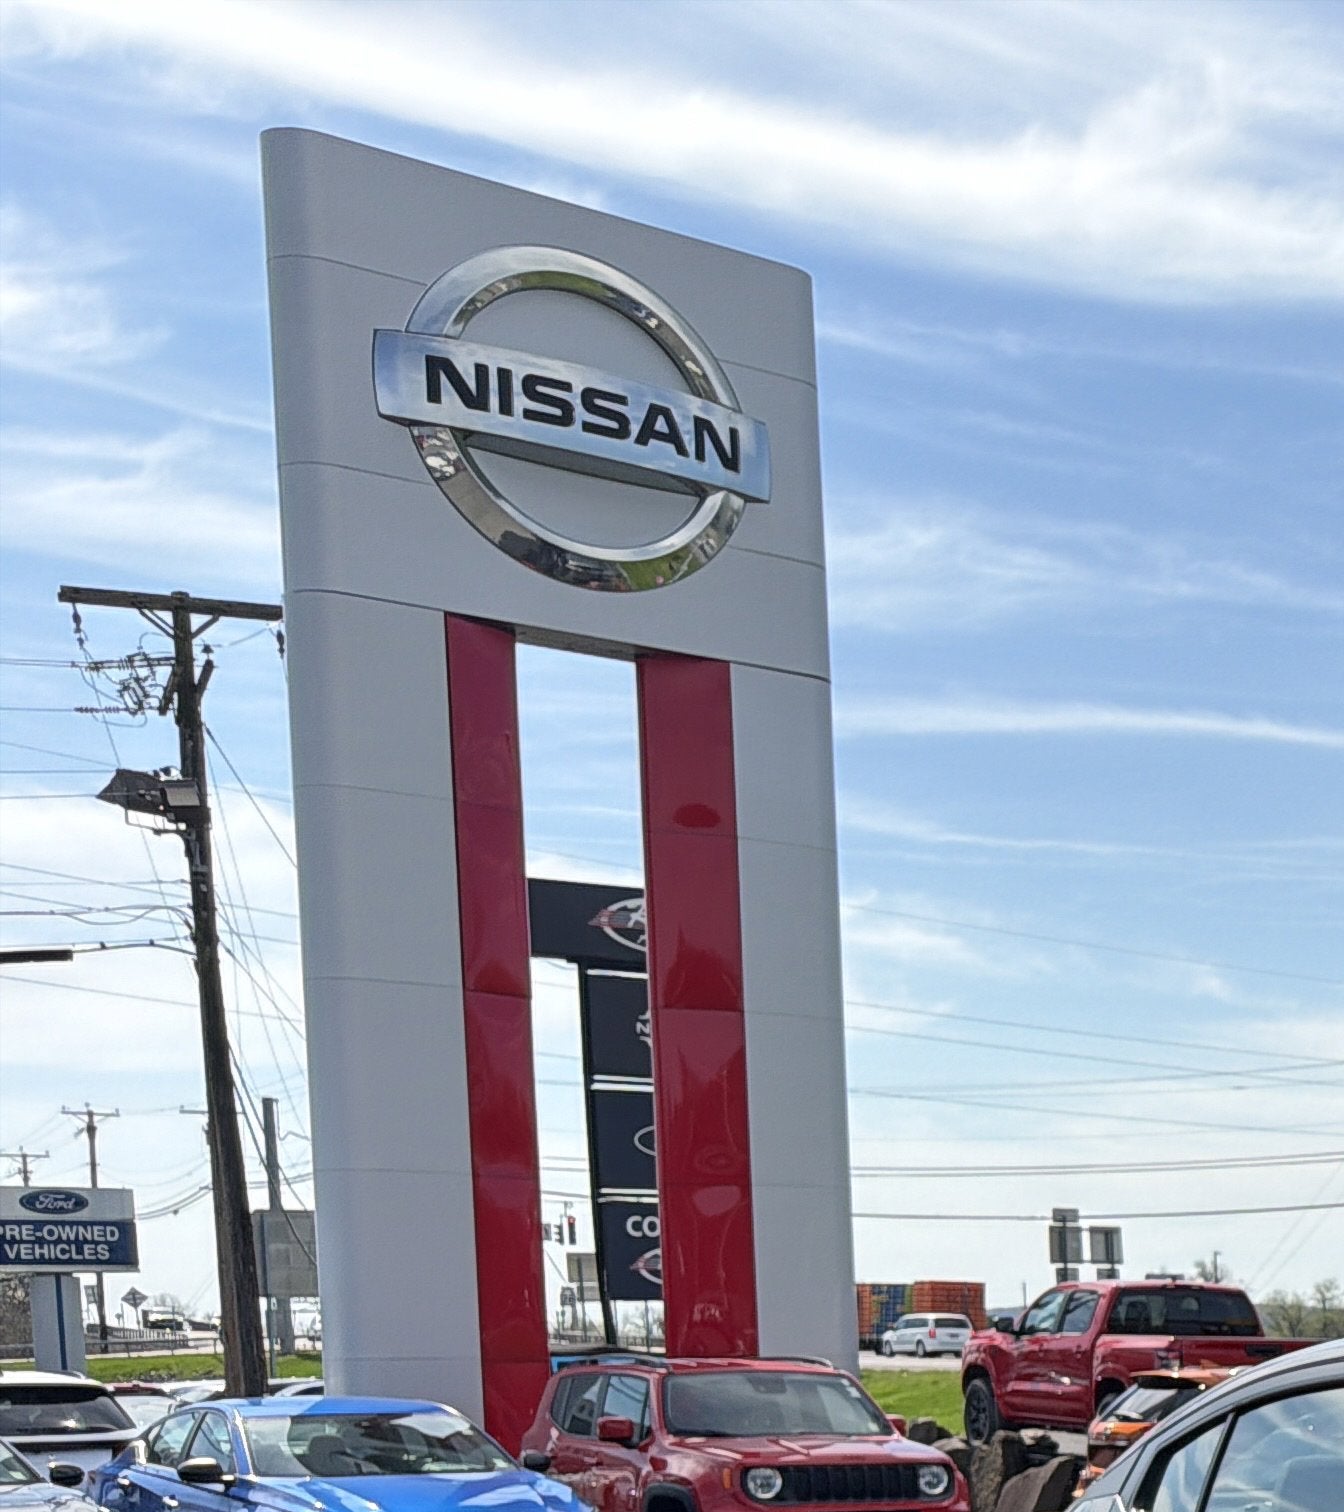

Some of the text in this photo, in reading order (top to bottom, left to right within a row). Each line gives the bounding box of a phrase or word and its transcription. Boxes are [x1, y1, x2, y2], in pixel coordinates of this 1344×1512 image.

[425, 354, 741, 474] NISSAN
[35, 1193, 76, 1210] Ford
[4, 1243, 110, 1260] VEHICLES
